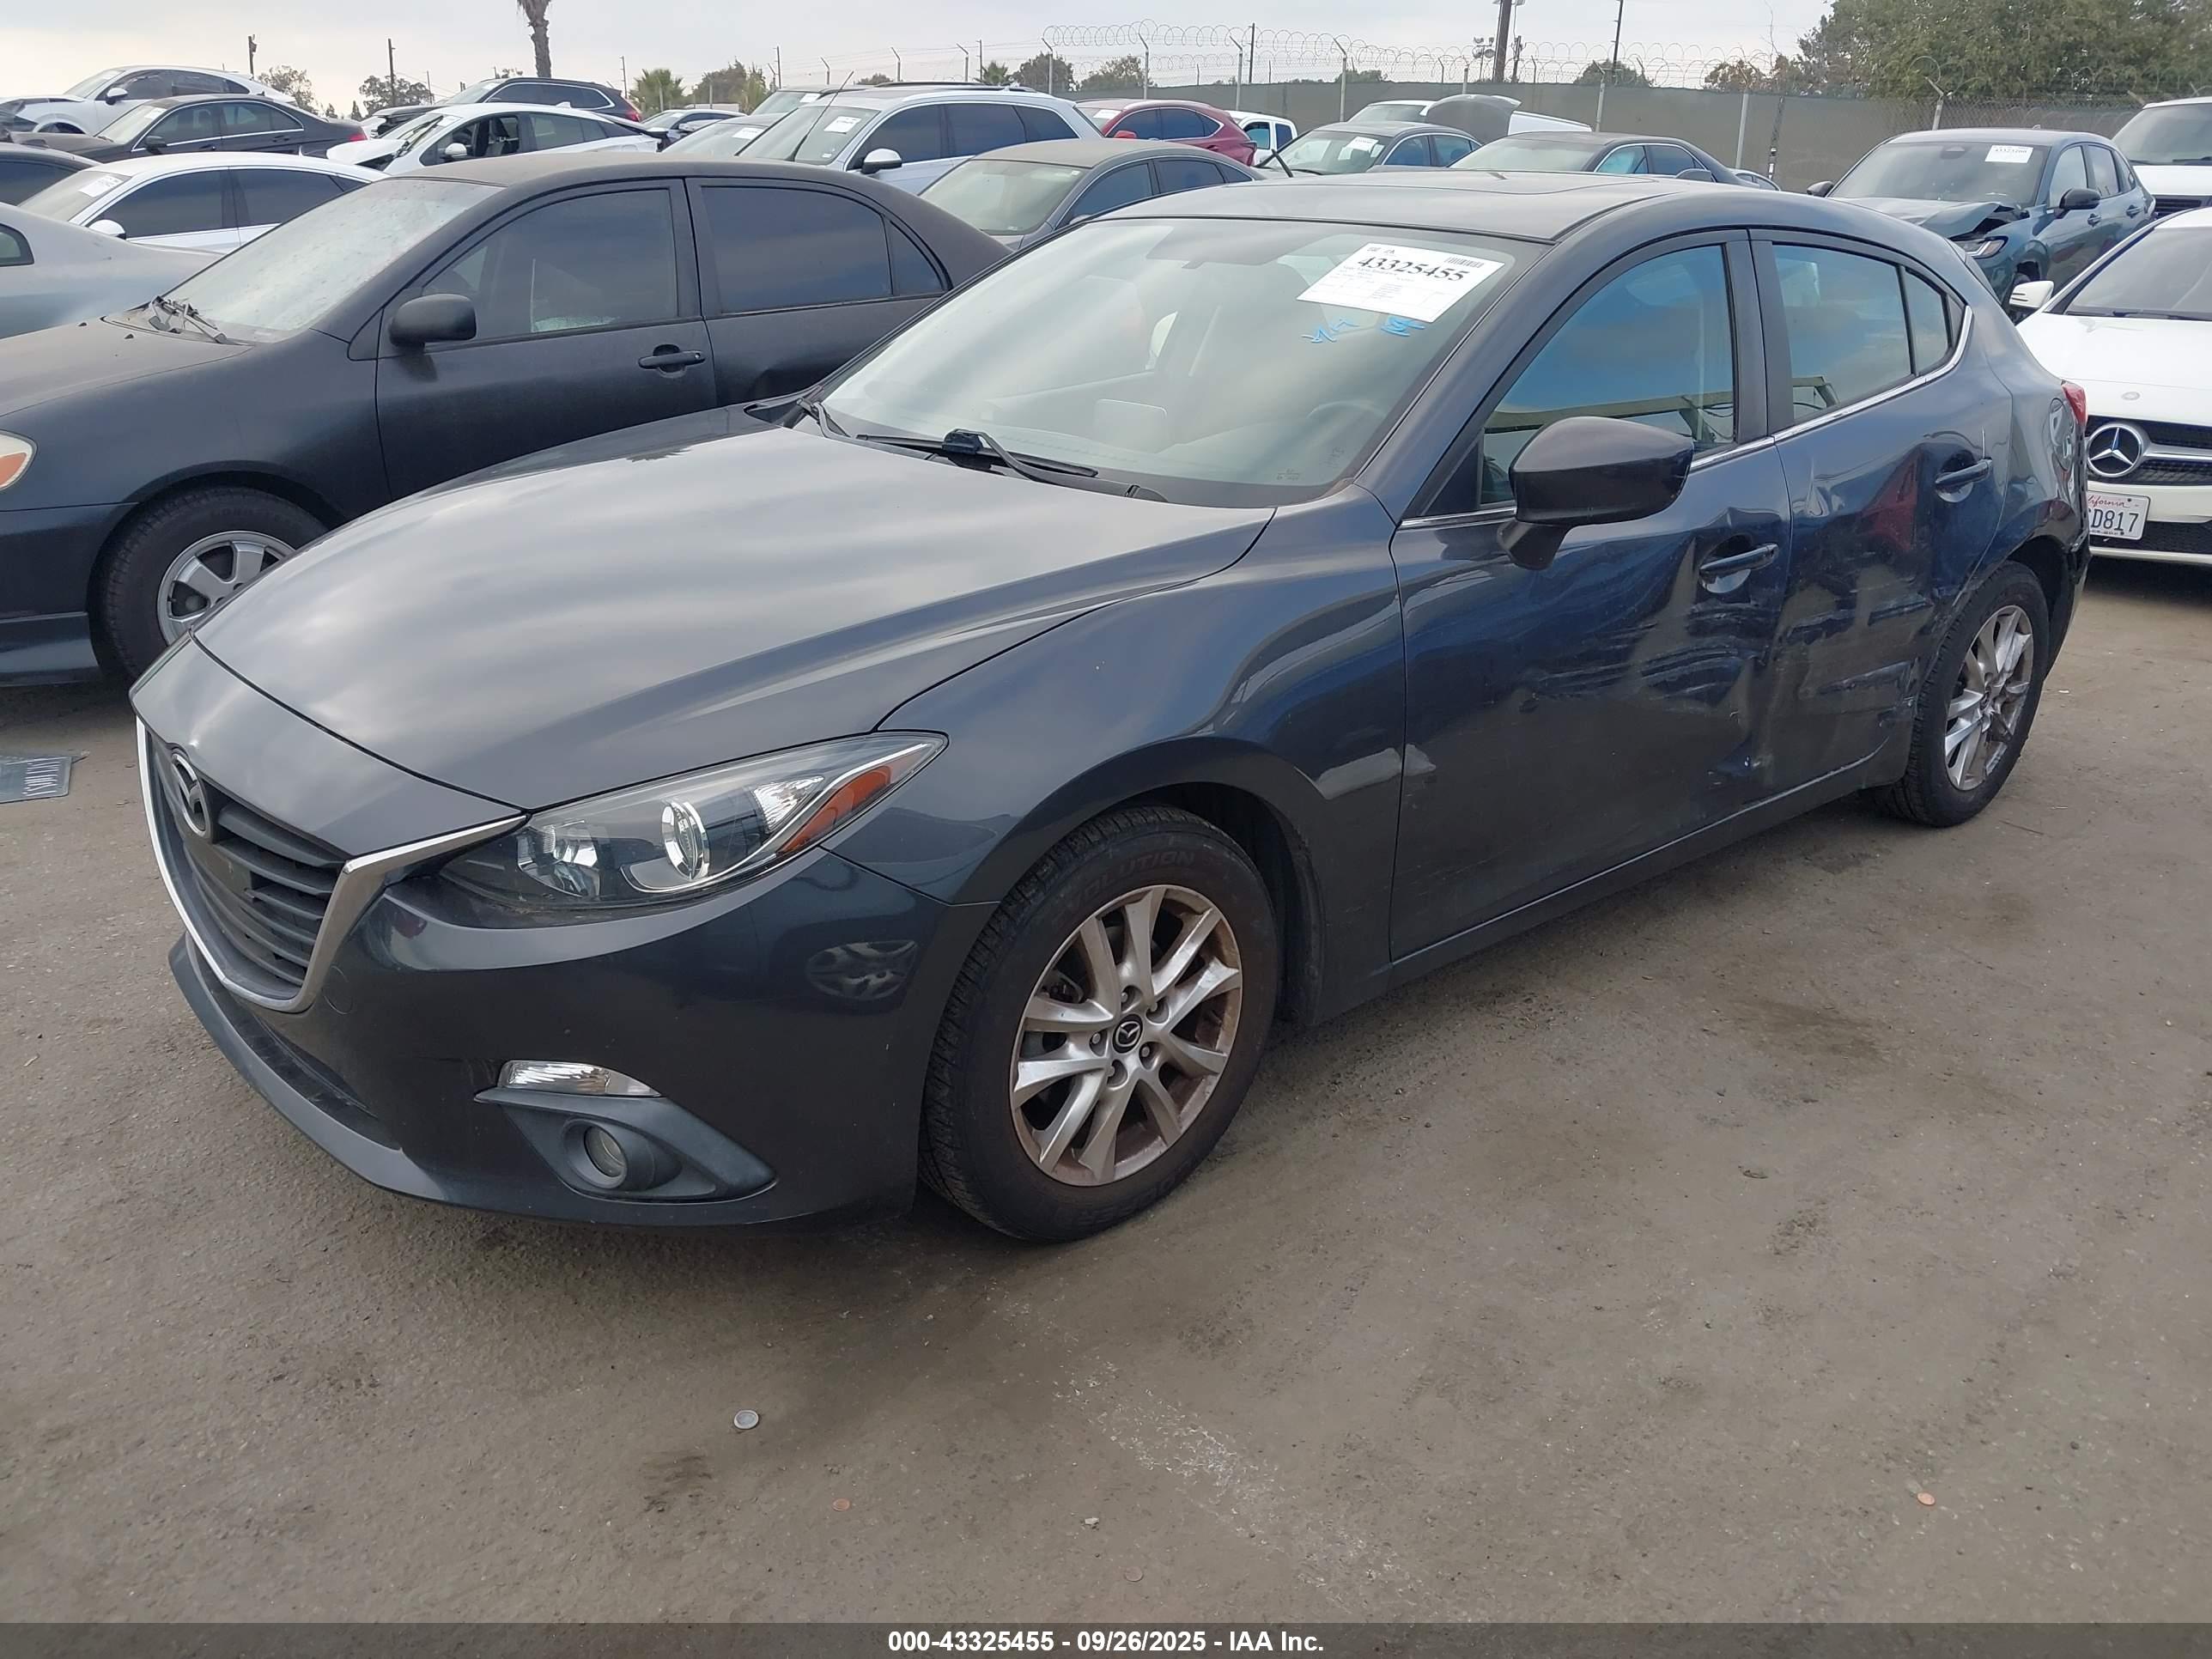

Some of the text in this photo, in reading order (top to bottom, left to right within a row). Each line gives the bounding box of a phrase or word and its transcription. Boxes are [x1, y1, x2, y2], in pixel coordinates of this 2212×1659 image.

[1357, 256, 1471, 282] 43325455
[2088, 495, 2130, 508] lifornia
[2088, 508, 2139, 532] D817
